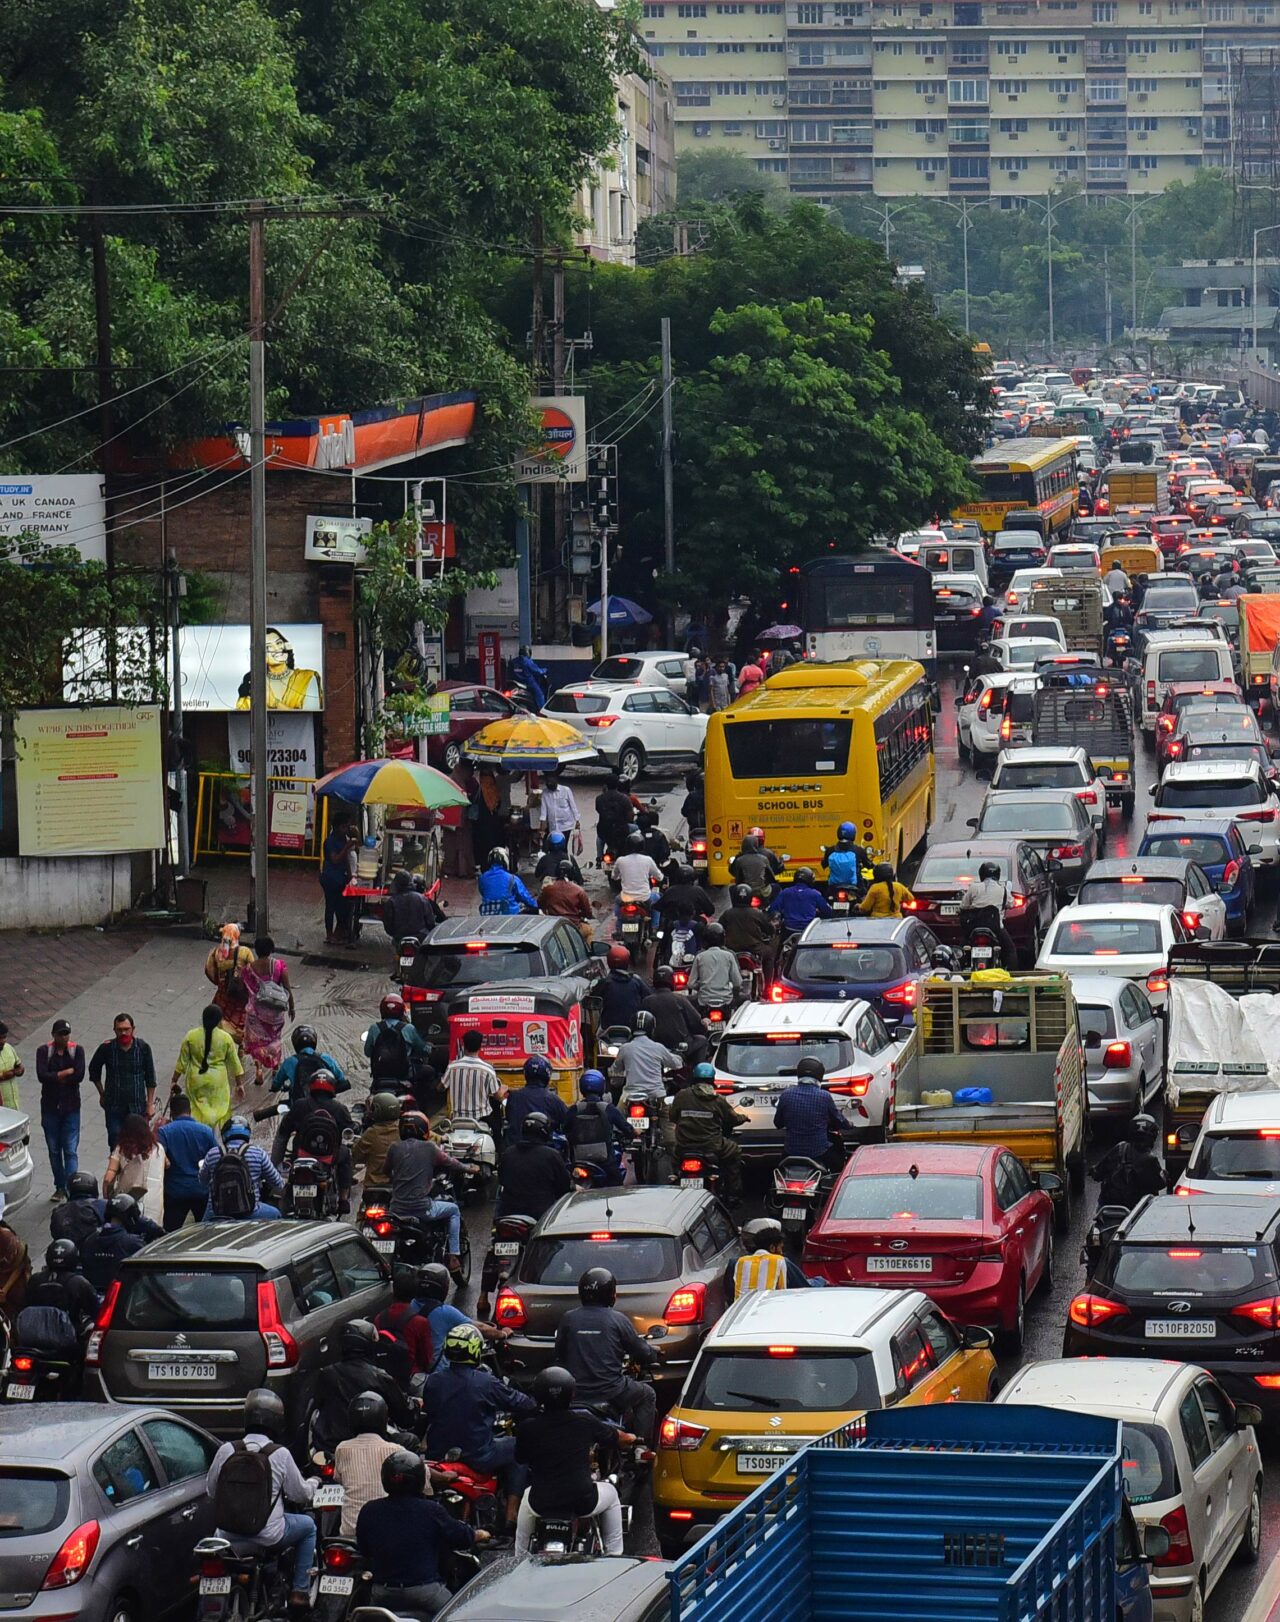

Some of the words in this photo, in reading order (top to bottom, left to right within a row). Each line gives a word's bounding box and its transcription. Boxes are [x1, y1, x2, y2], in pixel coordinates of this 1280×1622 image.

[12, 498, 26, 506] UK
[34, 498, 76, 506] CANADA
[32, 511, 72, 519] FRANCE
[19, 524, 70, 533] GERMANY
[182, 699, 210, 709] wellery
[136, 711, 150, 721] GRT
[76, 724, 92, 732] THIS
[94, 722, 136, 731] TOGETHER!
[272, 764, 296, 777] ARE
[759, 784, 822, 793] EICHER
[276, 799, 299, 812] GRT
[757, 801, 800, 810] SCHOOL
[802, 799, 824, 809] BUS
[873, 1259, 931, 1269] TS10ER6616
[1152, 1323, 1214, 1334] TS10FB2050
[155, 1366, 166, 1377] TS
[169, 1366, 181, 1376] 18
[182, 1366, 188, 1376] G
[190, 1366, 215, 1377] 7030
